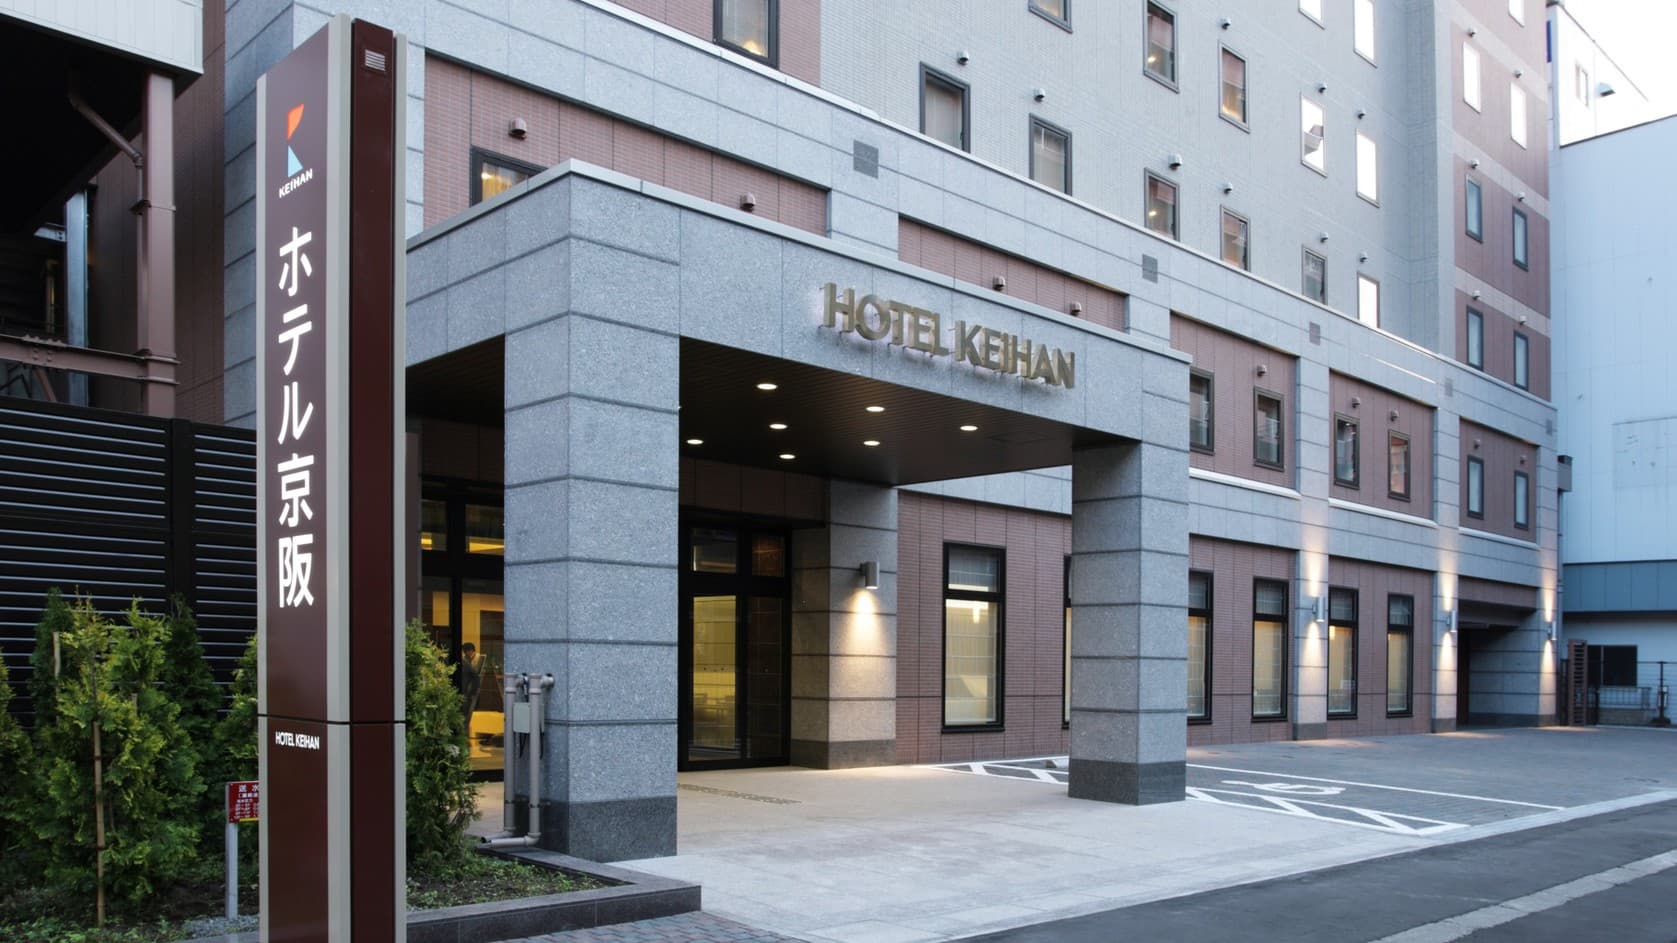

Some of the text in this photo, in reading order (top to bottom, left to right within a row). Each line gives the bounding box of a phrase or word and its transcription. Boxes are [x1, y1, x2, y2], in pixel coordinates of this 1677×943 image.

[278, 168, 313, 198] KEIHAN
[823, 282, 1075, 389] HOTEL KEIHAN
[277, 226, 314, 609] ホテル京阪
[275, 731, 320, 750] HOTEL KEIHAN
